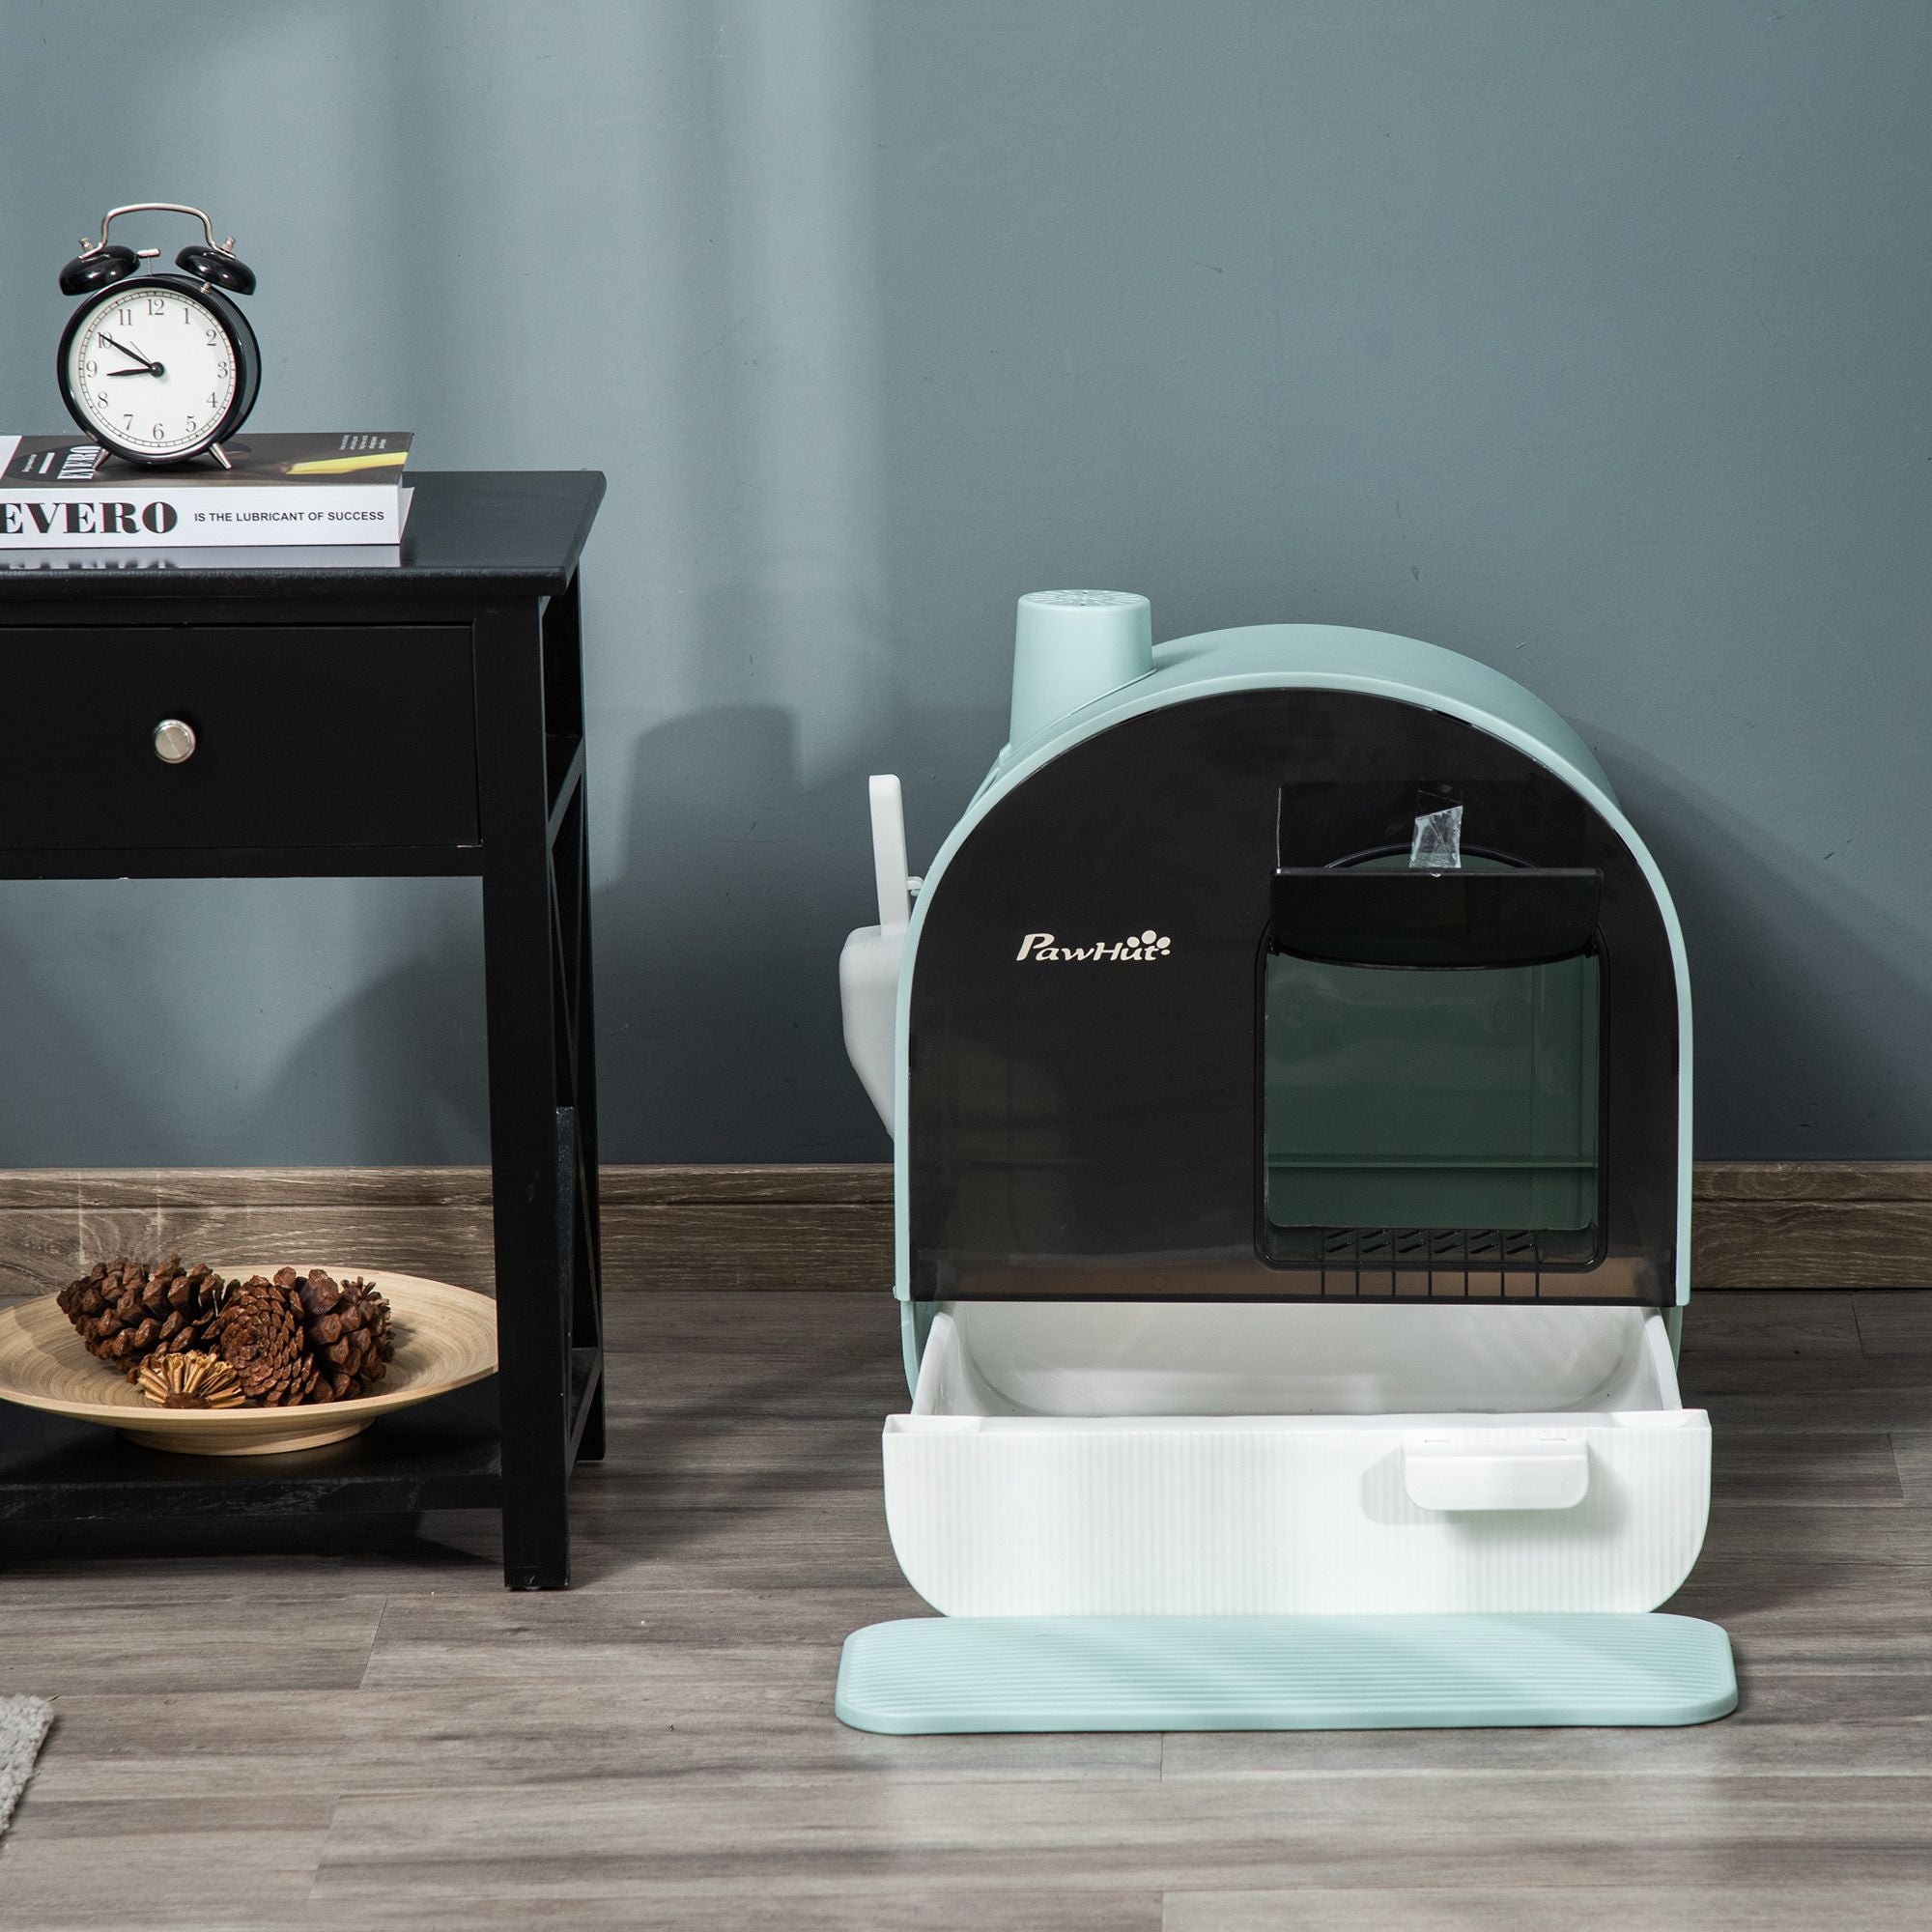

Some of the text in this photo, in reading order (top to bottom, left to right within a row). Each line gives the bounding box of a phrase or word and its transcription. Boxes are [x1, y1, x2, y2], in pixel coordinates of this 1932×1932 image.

[148, 298, 164, 316] 12
[119, 309, 132, 326] 11
[184, 308, 190, 325] 1
[98, 331, 112, 349] 10
[206, 329, 216, 346] 2
[86, 361, 97, 378] 9
[217, 361, 228, 379] 3
[98, 391, 109, 409] 8
[206, 392, 218, 408] 4
[123, 414, 133, 431] 7
[186, 416, 196, 433] 5
[153, 423, 164, 440] 6
[0, 502, 384, 533] EVERO IS THE LUBRICANT OF SUCCESS
[1016, 932, 1159, 961] PawHut
